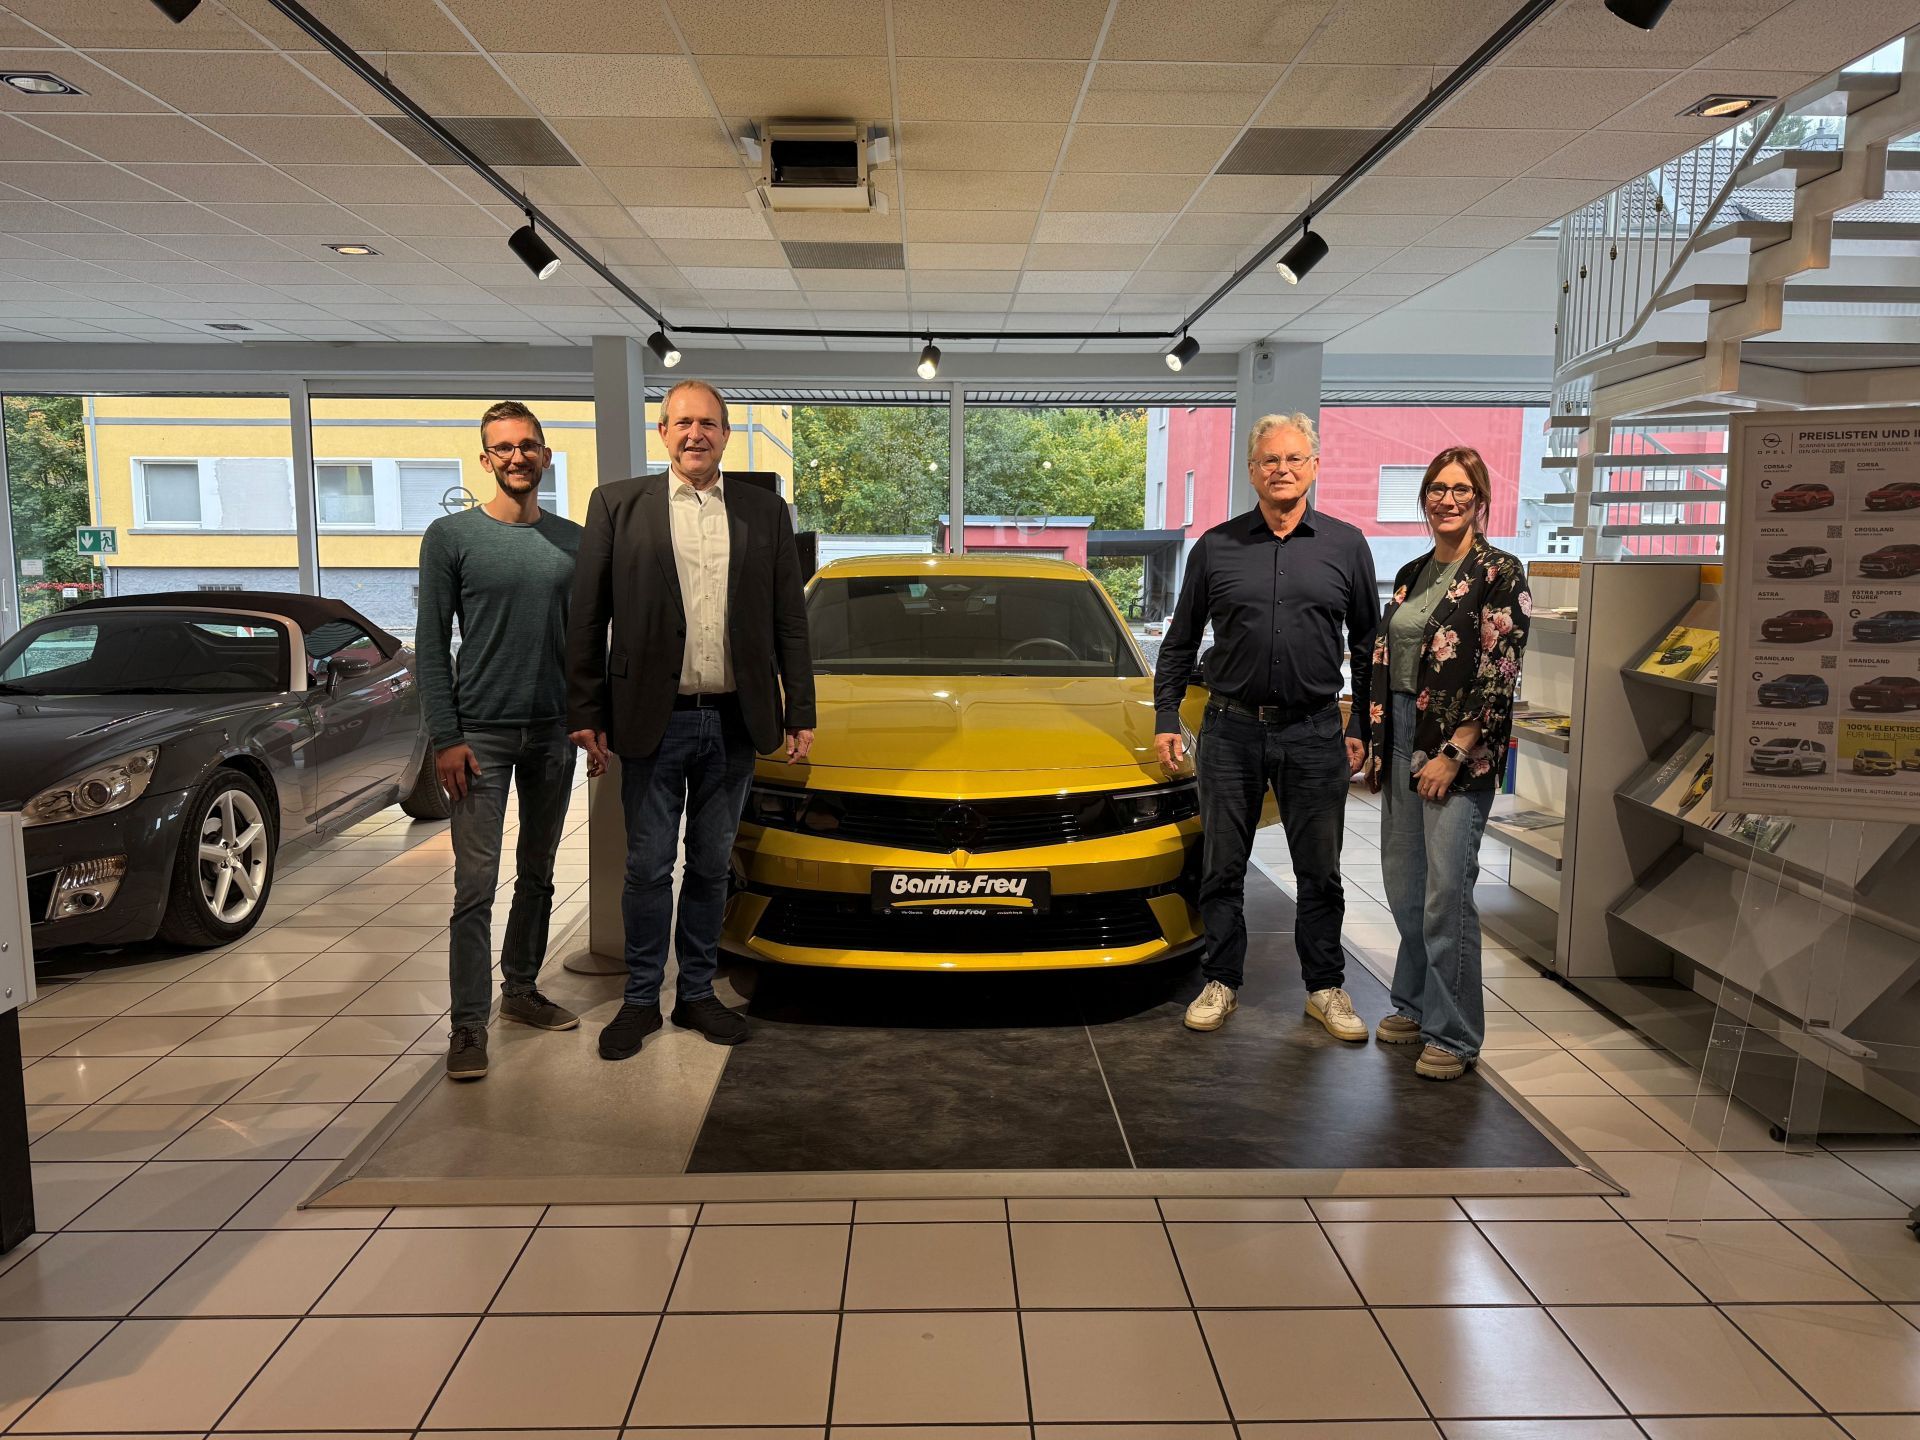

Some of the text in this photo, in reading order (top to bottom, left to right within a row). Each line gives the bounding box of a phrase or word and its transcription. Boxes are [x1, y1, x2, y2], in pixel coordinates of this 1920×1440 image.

[1799, 430, 1878, 441] PREISLISTEN
[1882, 429, 1910, 439] UND
[1847, 723, 1872, 731] 100%
